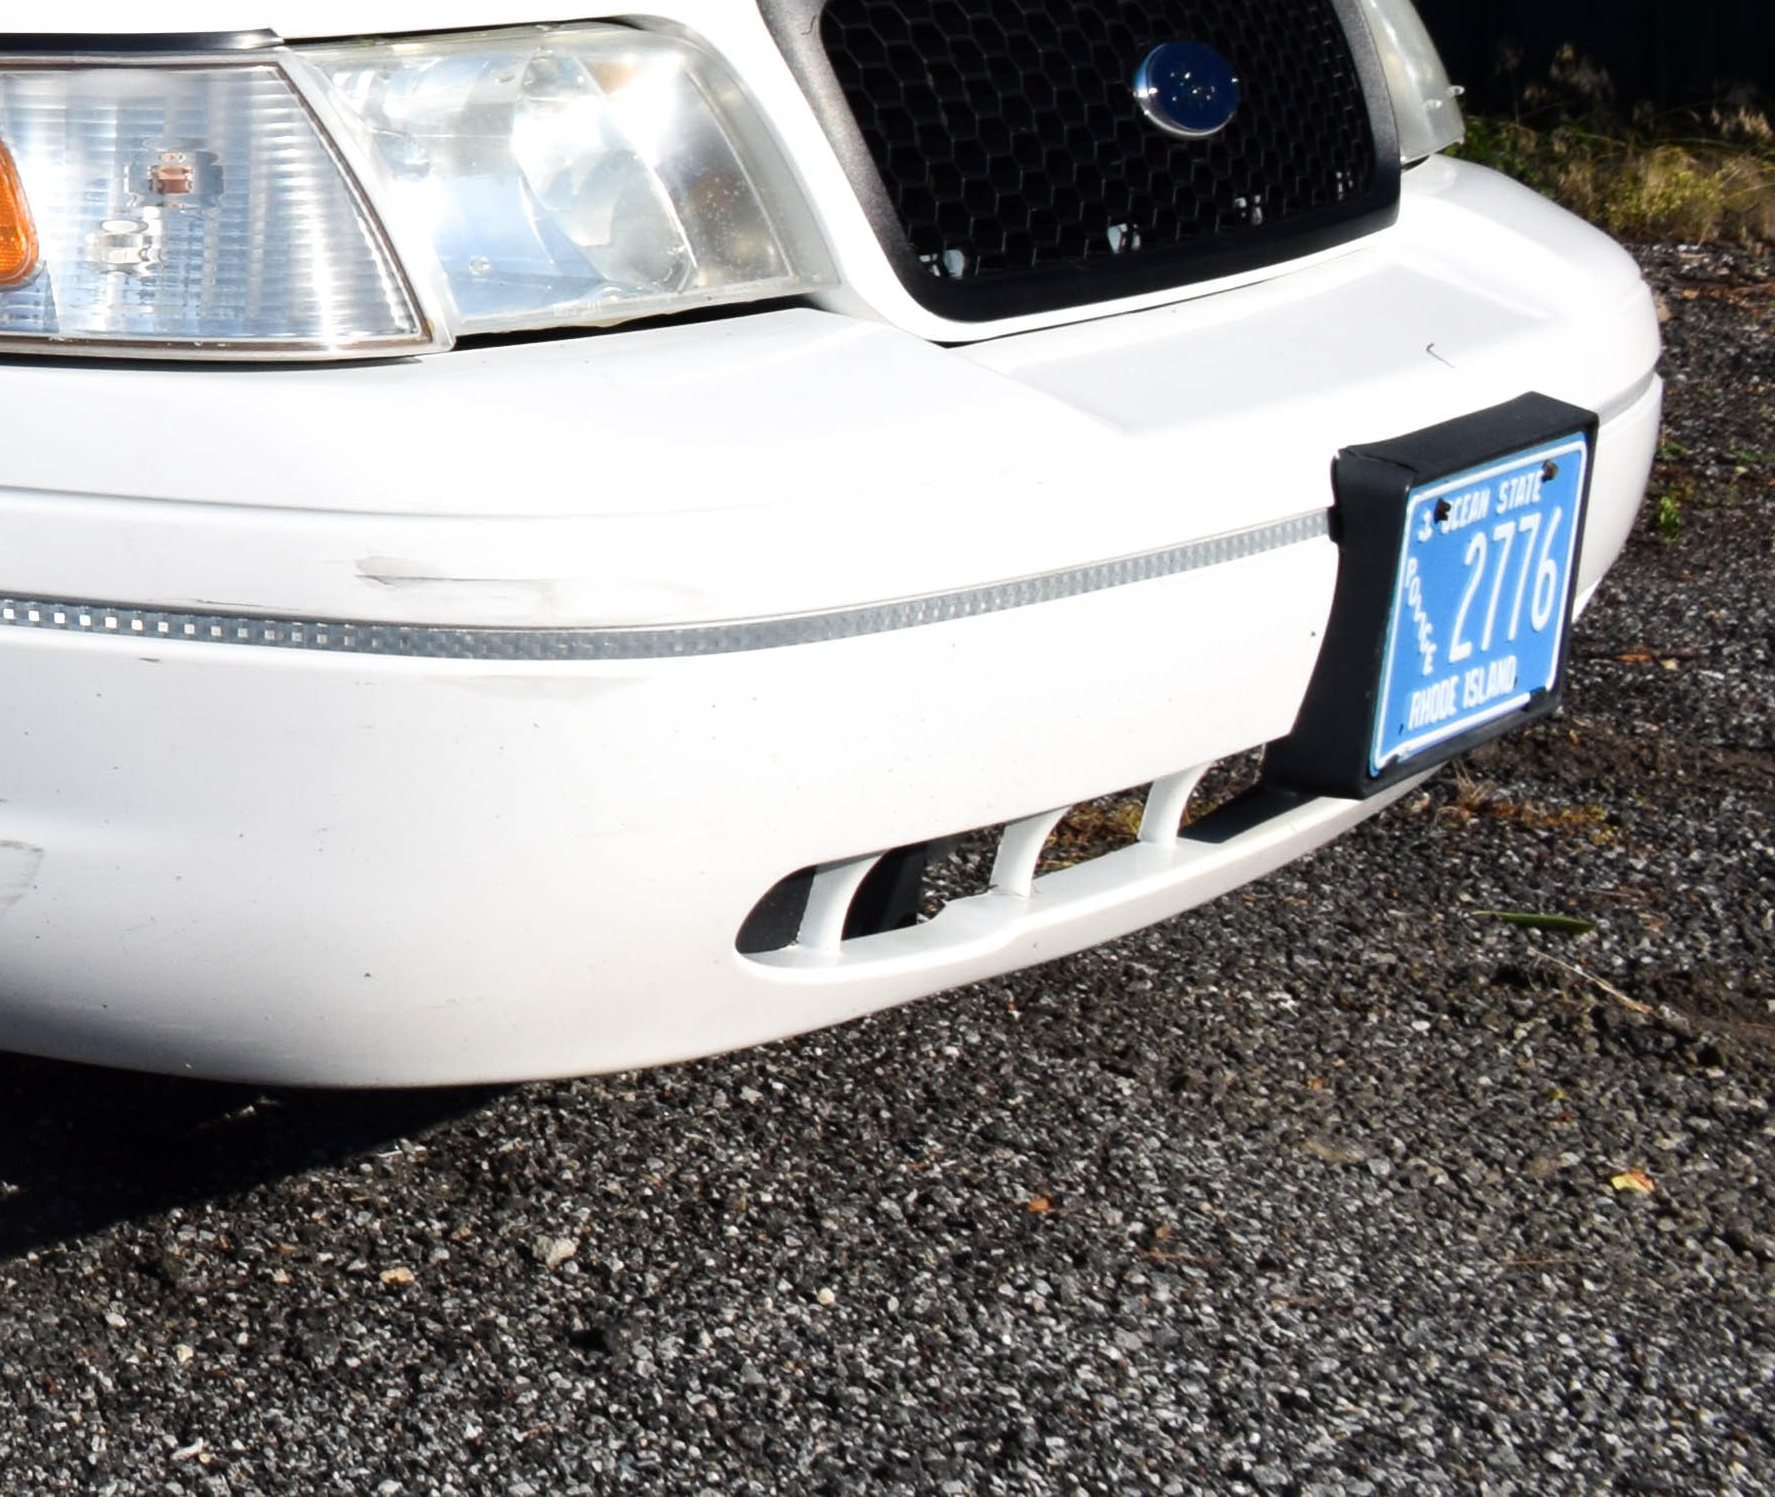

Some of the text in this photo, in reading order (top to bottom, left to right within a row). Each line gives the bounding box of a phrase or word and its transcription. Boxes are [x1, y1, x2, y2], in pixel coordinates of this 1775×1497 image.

[1497, 470, 1543, 513] STATE
[1402, 557, 1437, 676] POLICE
[1449, 507, 1563, 663] 2776
[1409, 655, 1517, 730] RHODE ISLAND
